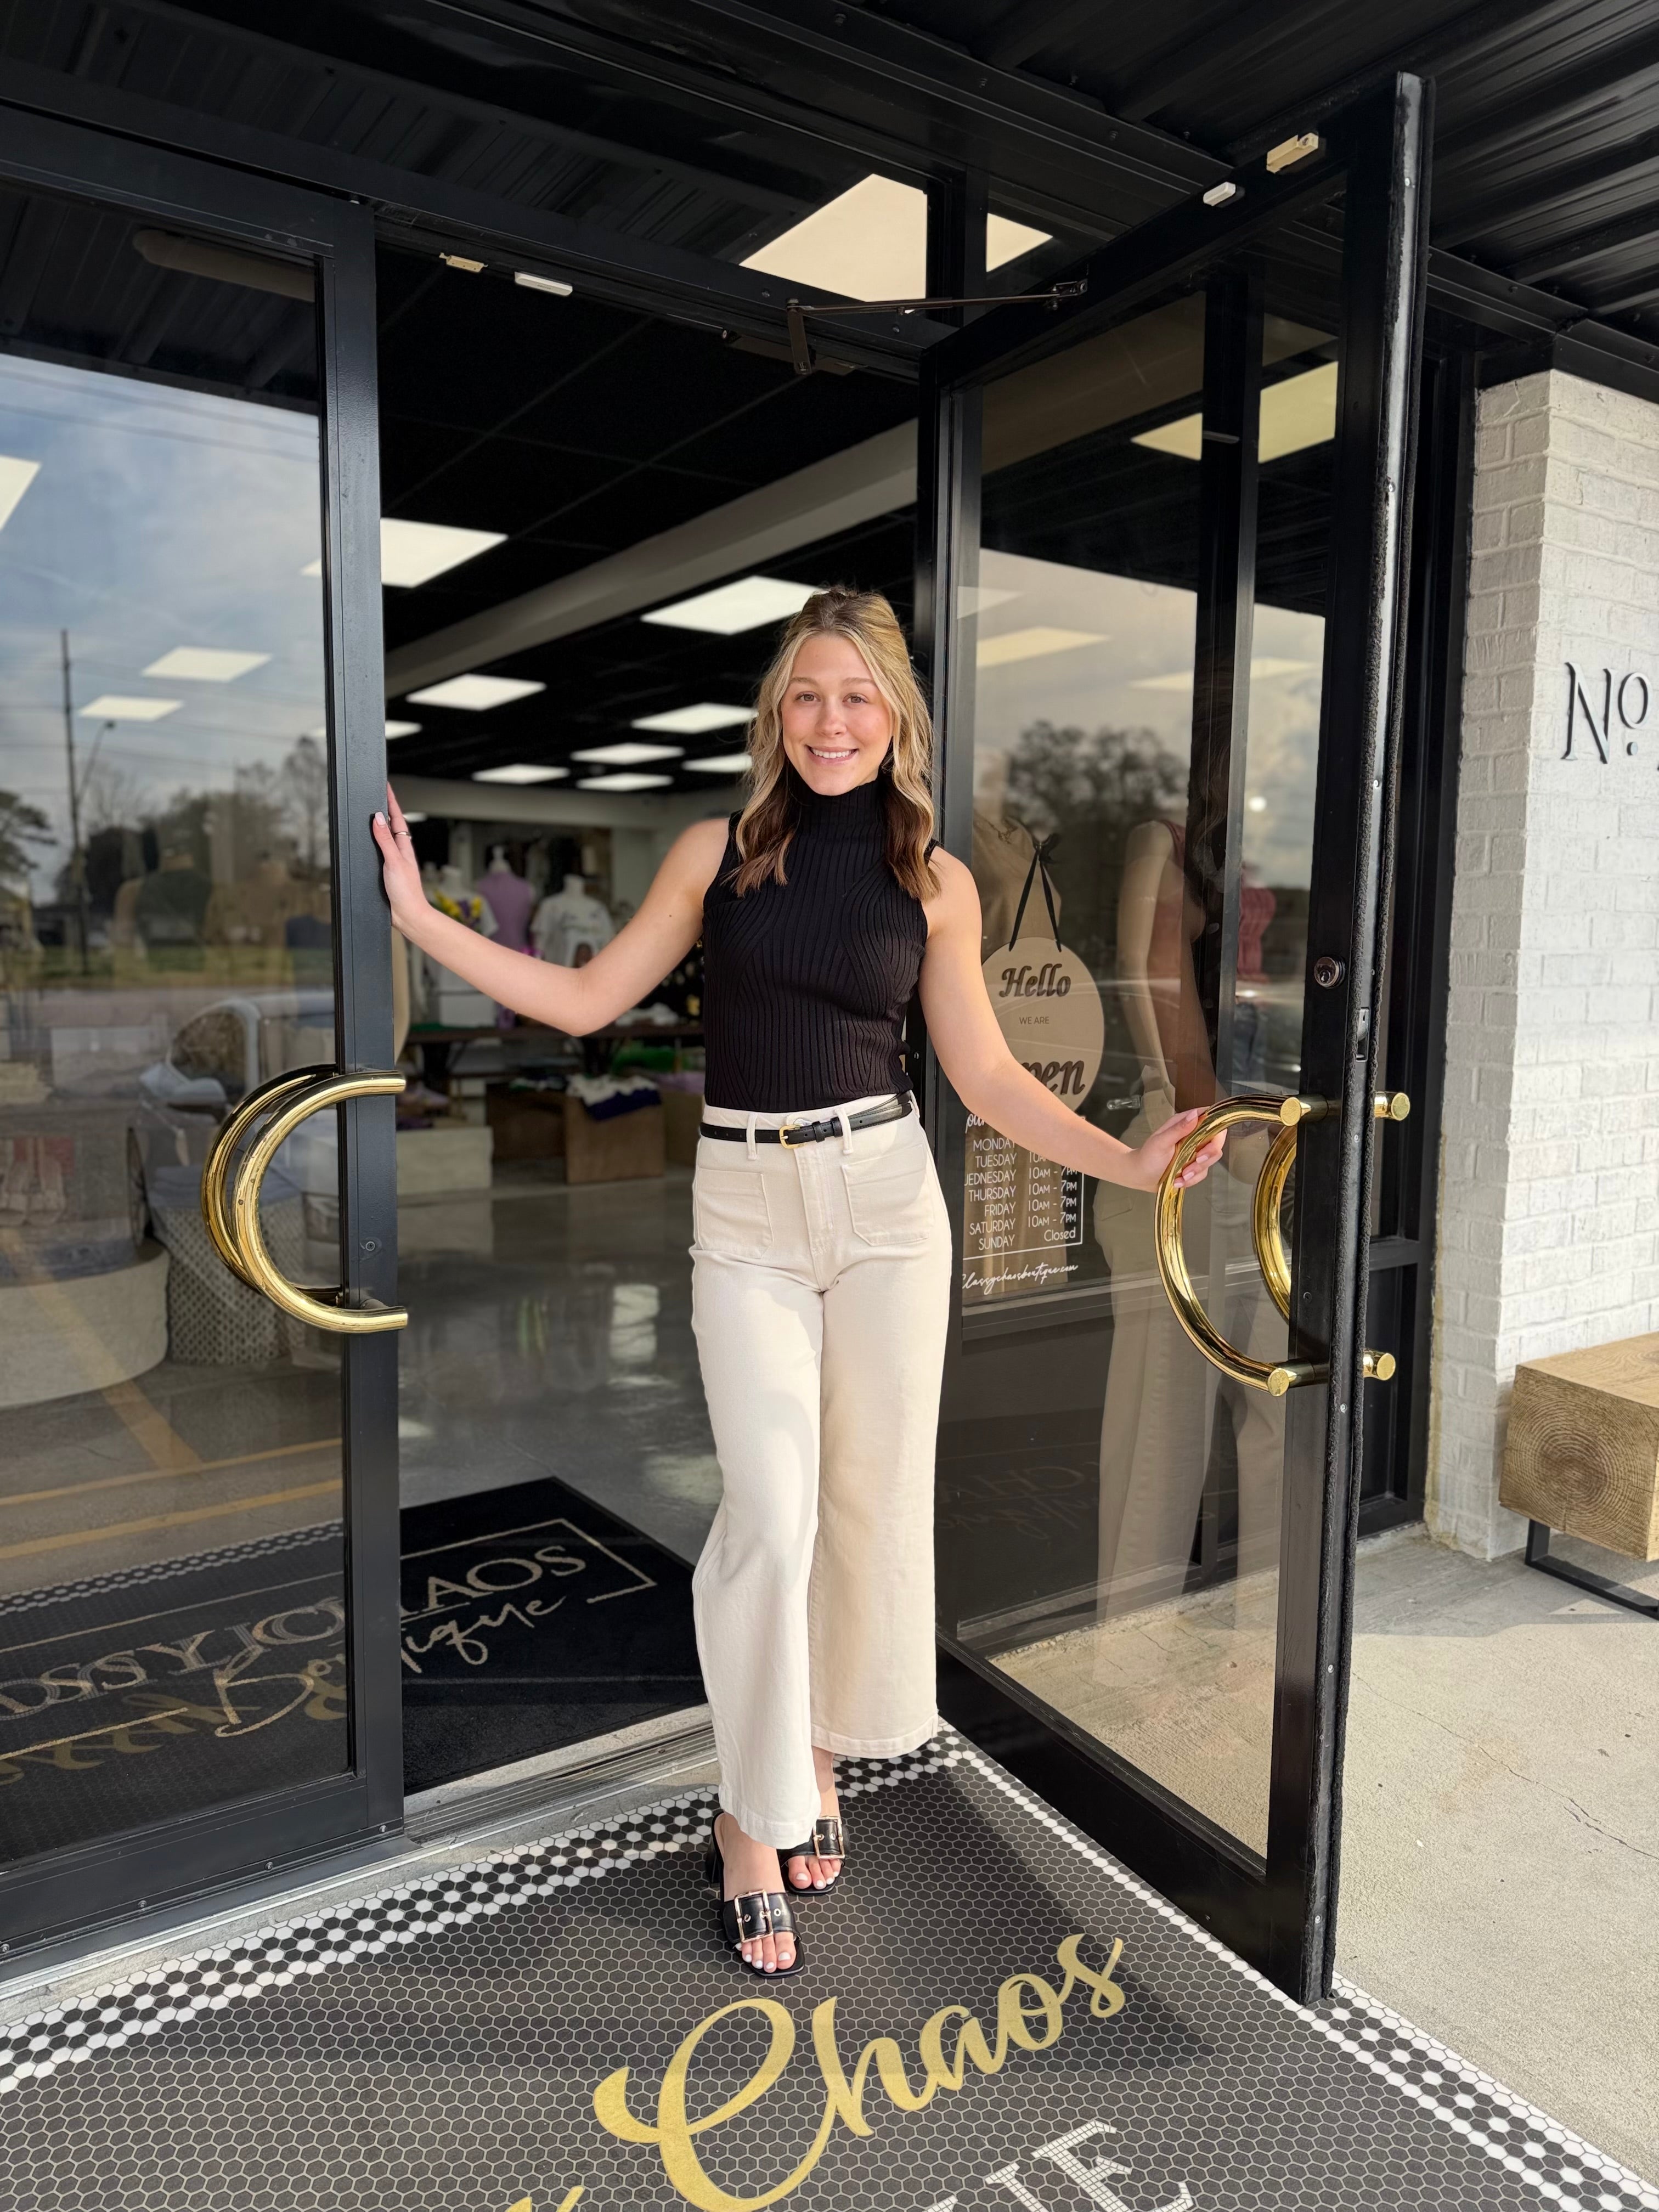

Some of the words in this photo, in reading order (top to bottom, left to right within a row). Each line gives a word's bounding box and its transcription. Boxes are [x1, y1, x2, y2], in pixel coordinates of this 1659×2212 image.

[998, 963, 1071, 997] Hello
[1019, 1016, 1032, 1025] WE
[1034, 1016, 1050, 1024] ARE
[975, 1153, 1017, 1168] TUESDAY
[968, 1186, 1017, 1202] THURSDAY
[1028, 1183, 1050, 1195] 10AM
[1060, 1180, 1077, 1193] 7PM
[984, 1201, 1016, 1217] FRIDAY
[1028, 1199, 1050, 1212] 10AM
[1060, 1196, 1077, 1208] 7PM
[969, 1218, 1016, 1235] SATURDAY
[1028, 1215, 1049, 1228] 10AM
[1060, 1212, 1076, 1224] 7PM
[978, 1234, 1015, 1251] SUNDAY
[1043, 1227, 1076, 1242] Closed
[593, 1934, 1125, 2212] Chaos
